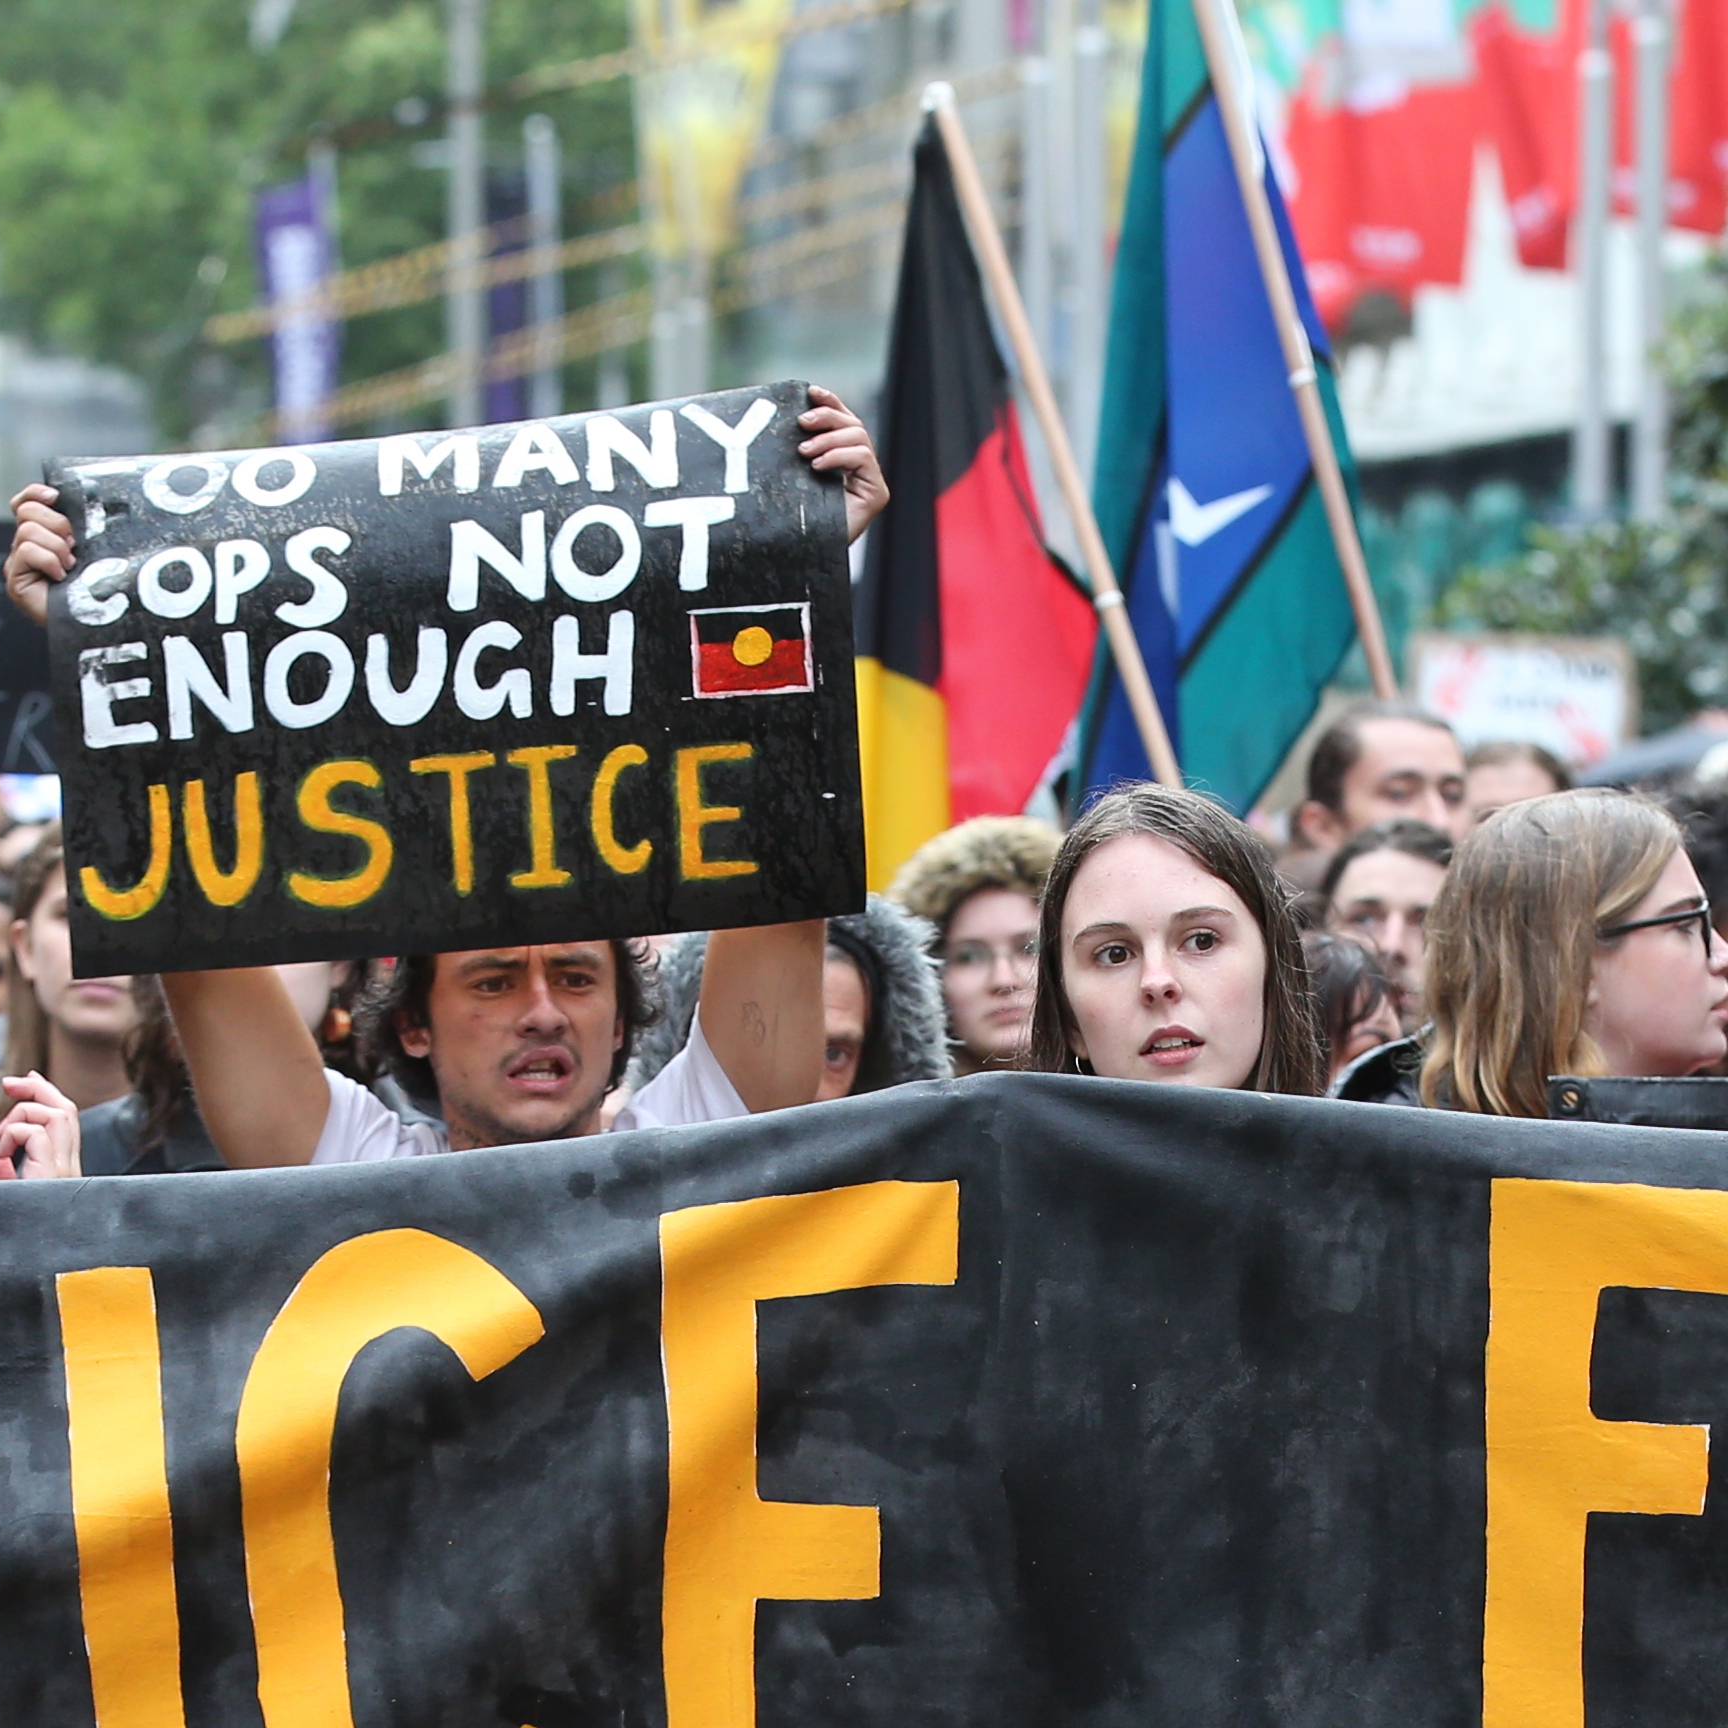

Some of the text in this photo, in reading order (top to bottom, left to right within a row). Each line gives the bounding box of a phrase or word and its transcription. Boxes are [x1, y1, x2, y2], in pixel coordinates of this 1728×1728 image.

[378, 397, 778, 498] MANY
[67, 495, 735, 628] COPS NOT
[77, 610, 635, 749] ENOUGH
[79, 742, 760, 922] JUSTICE
